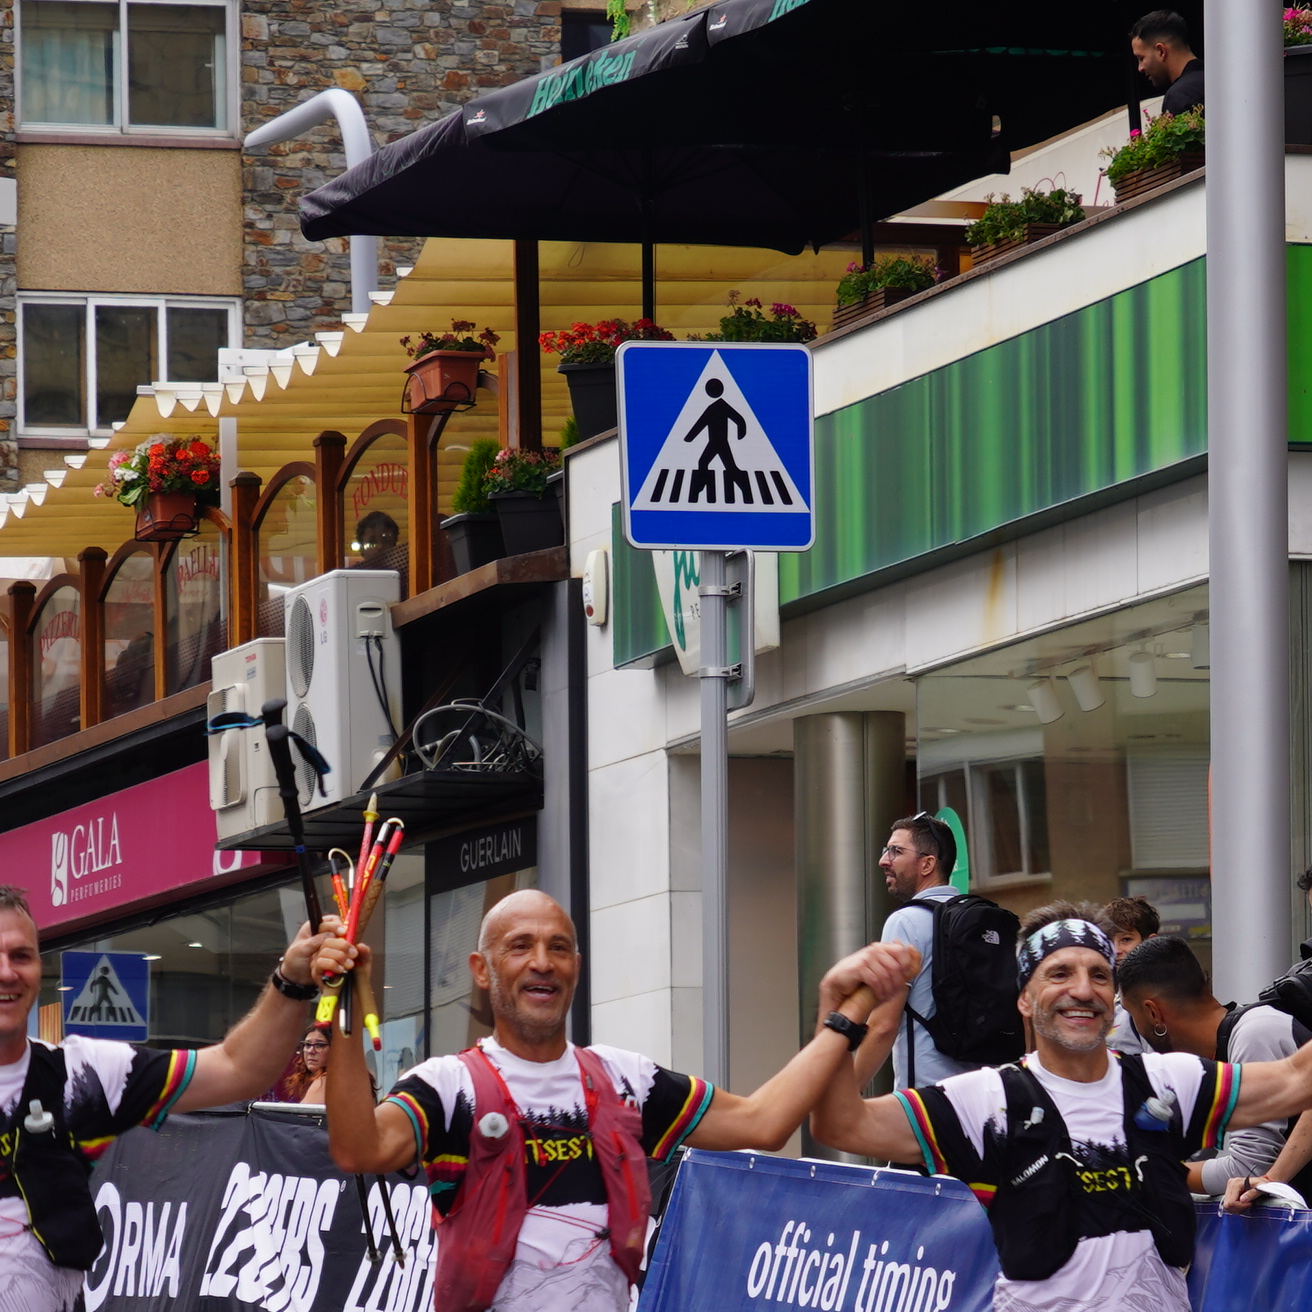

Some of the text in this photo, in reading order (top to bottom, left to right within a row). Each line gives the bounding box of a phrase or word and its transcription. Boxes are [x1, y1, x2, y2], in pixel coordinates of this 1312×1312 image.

[320, 632, 328, 645] LG
[70, 811, 122, 880] GALA
[459, 827, 522, 873] GUERLAIN
[70, 874, 122, 903] PERFUMERIES
[746, 1219, 861, 1312] official
